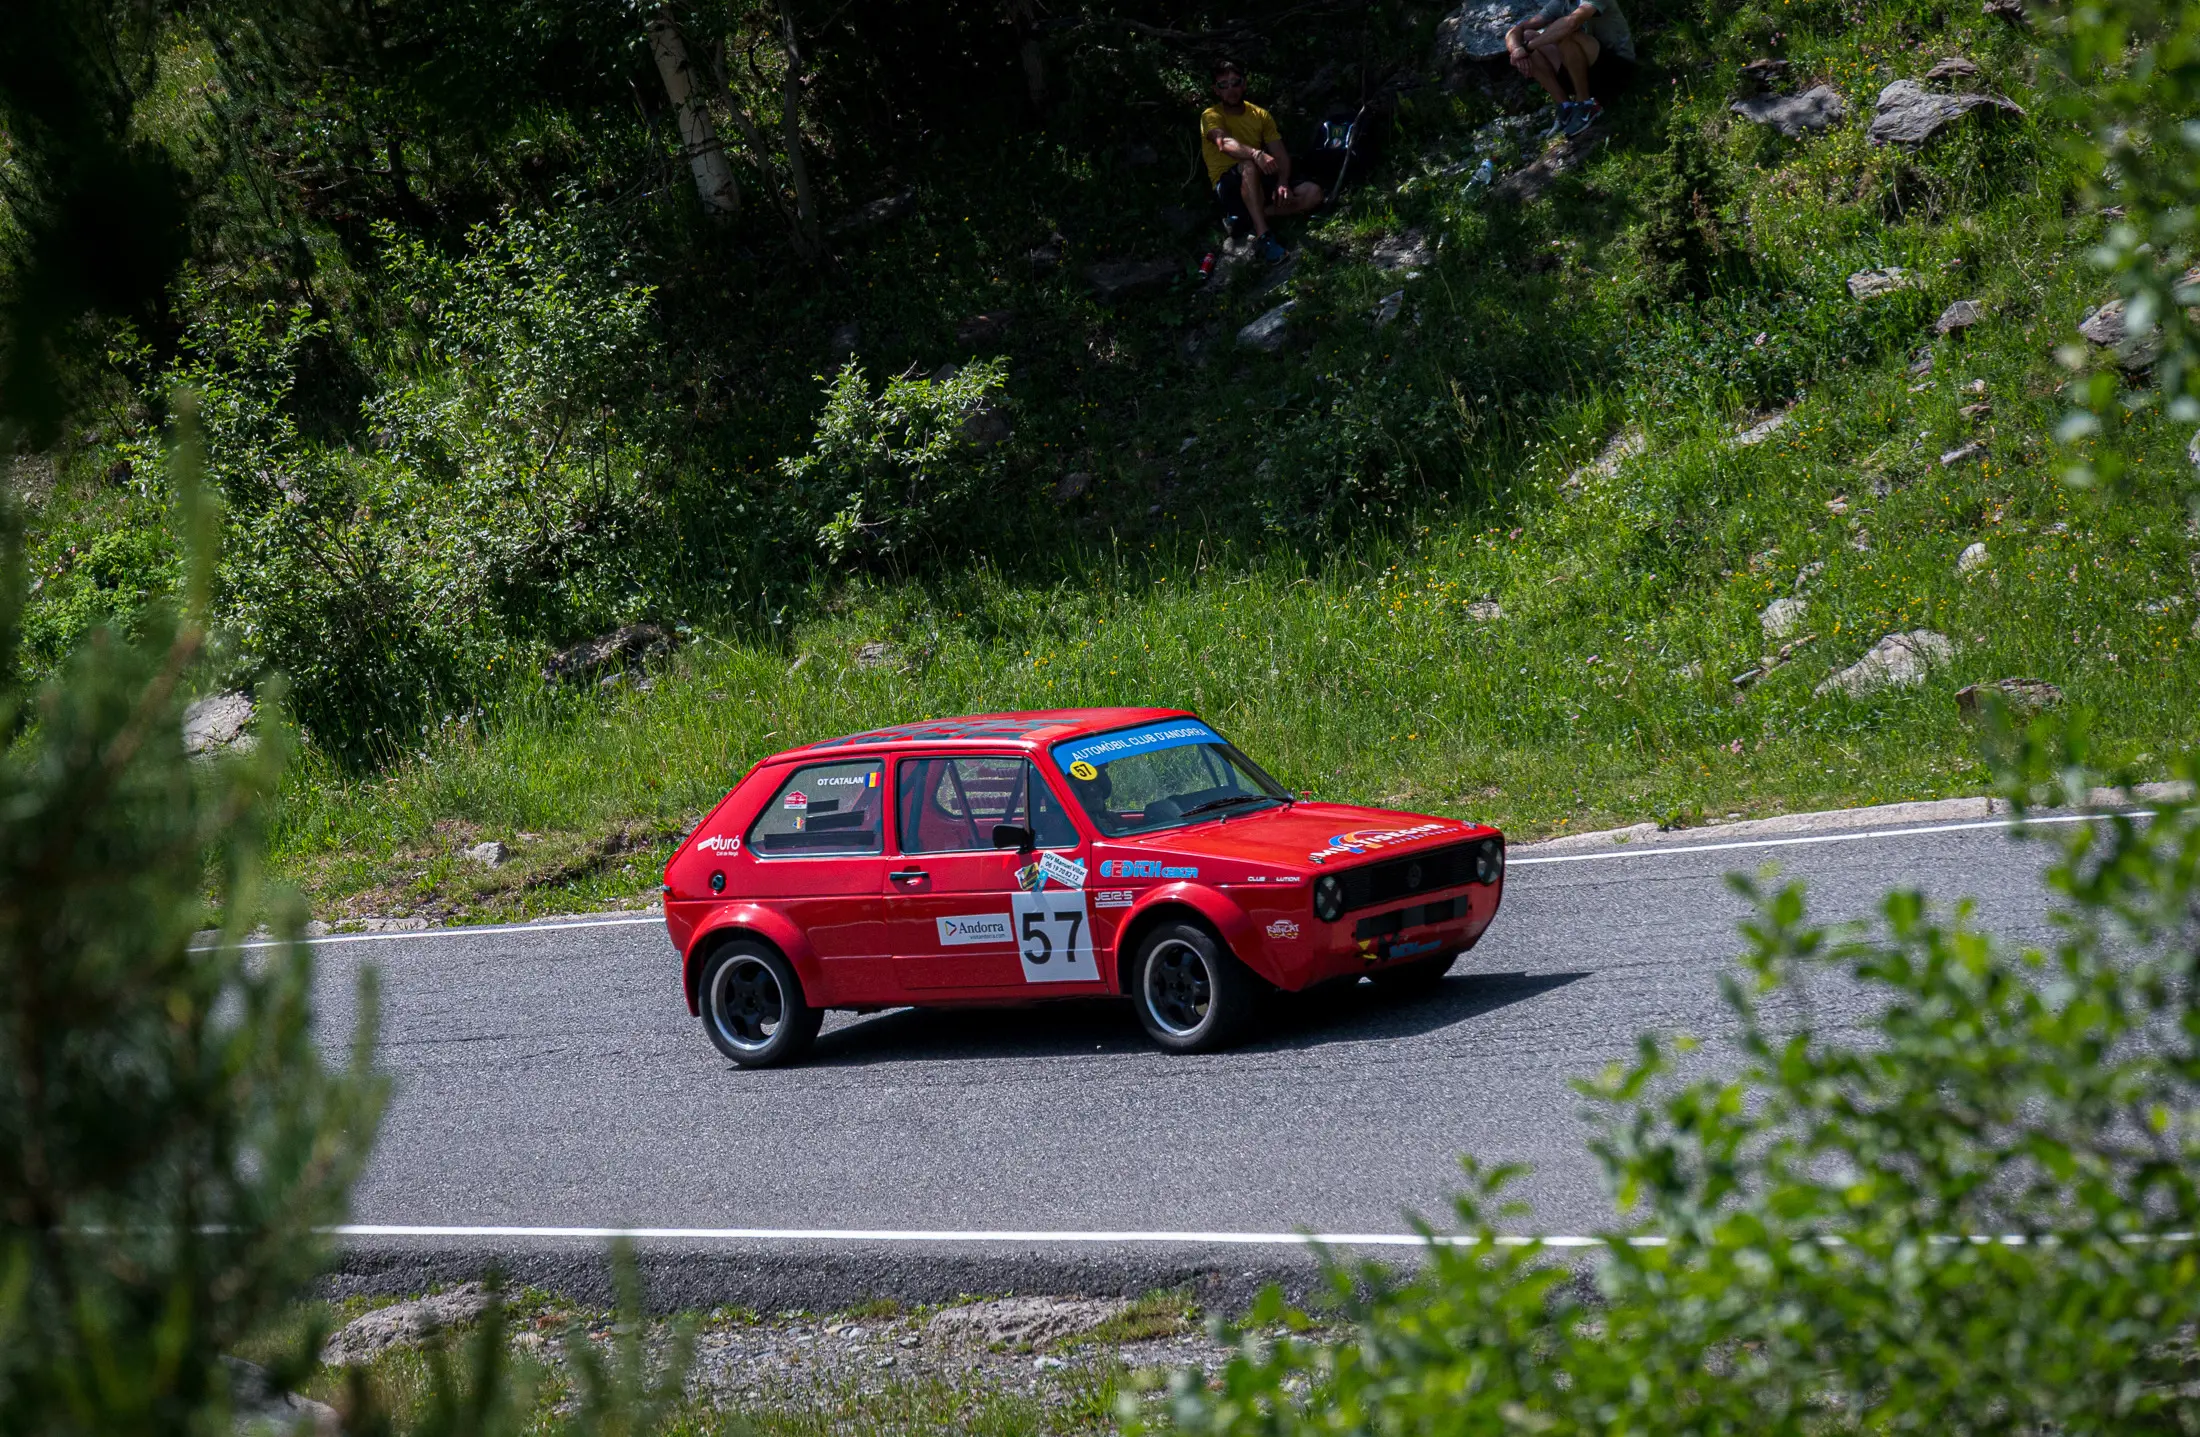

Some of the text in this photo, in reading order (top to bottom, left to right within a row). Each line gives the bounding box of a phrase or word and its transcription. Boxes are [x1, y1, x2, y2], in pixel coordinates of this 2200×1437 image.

[1130, 733, 1157, 746] CLUB
[1073, 763, 1092, 778] 57
[817, 776, 864, 786] OT CATALAN
[711, 834, 740, 850] duró
[959, 920, 1004, 934] Andorra
[1022, 911, 1083, 965] 57
